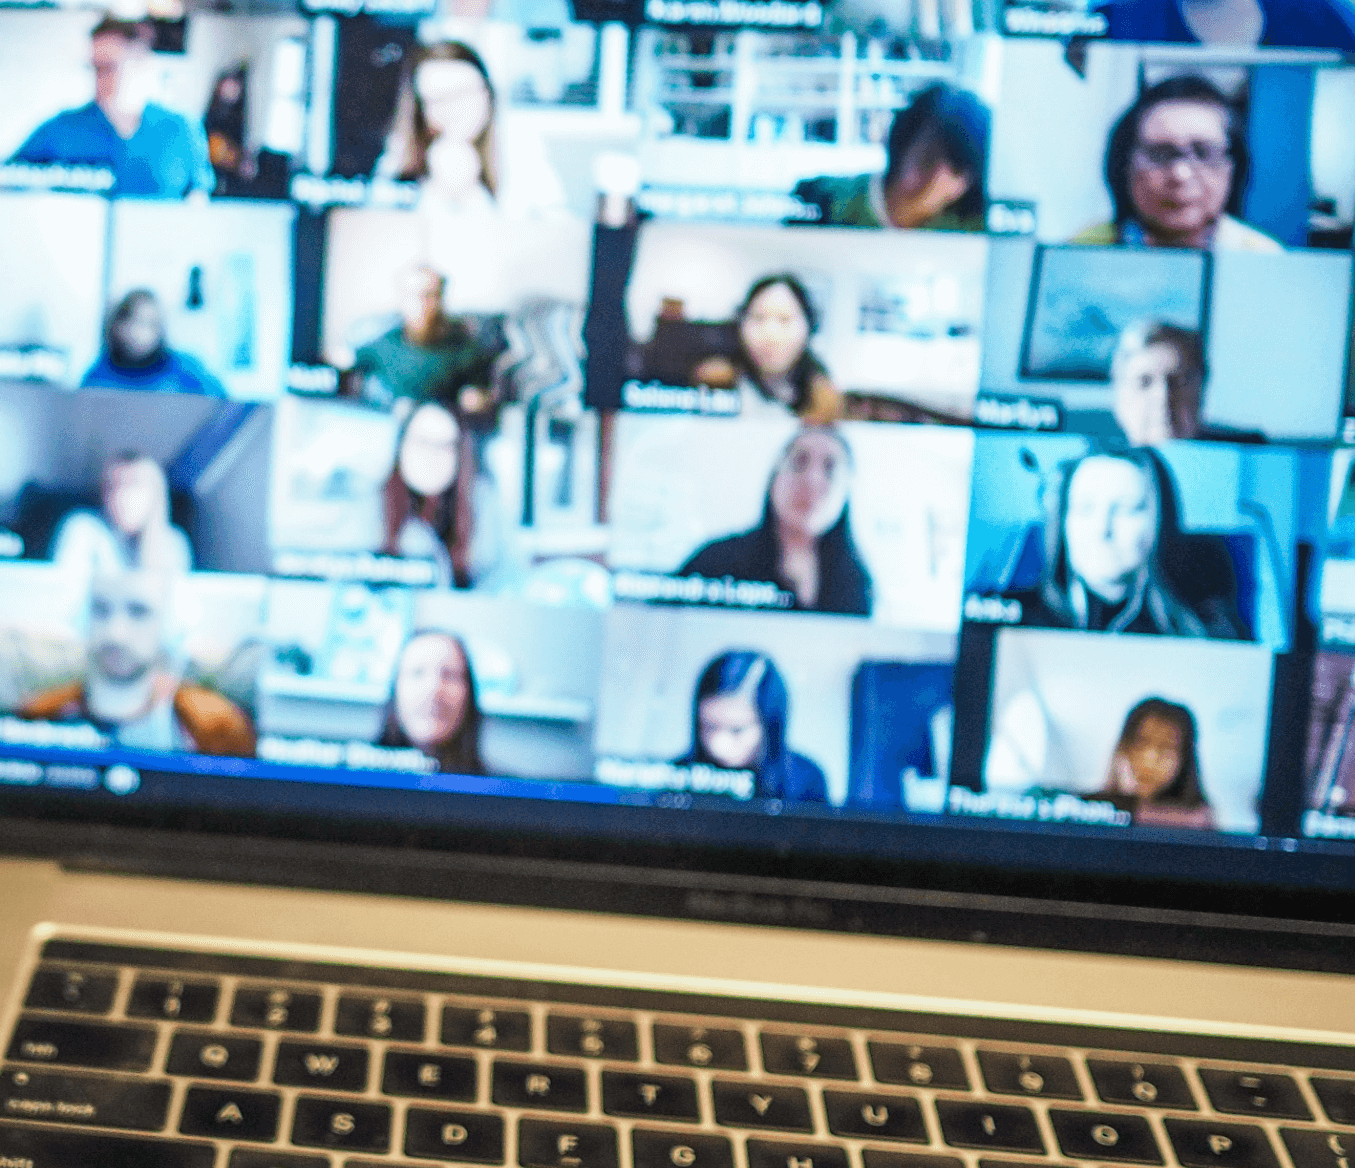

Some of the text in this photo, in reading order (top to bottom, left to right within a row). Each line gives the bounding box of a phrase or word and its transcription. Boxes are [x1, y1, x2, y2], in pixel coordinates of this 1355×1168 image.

[305, 1053, 339, 1075] W
[417, 1063, 442, 1087] E
[525, 1074, 551, 1097] R
[640, 1083, 661, 1106] T
[216, 1101, 244, 1125] A
[749, 1094, 773, 1116] Y
[861, 1104, 889, 1127] U
[330, 1112, 356, 1135] S
[441, 1123, 468, 1145] D
[981, 1114, 996, 1136] I
[557, 1134, 580, 1154] F
[1091, 1123, 1119, 1147] O
[1207, 1133, 1233, 1155] P
[670, 1145, 696, 1167] G
